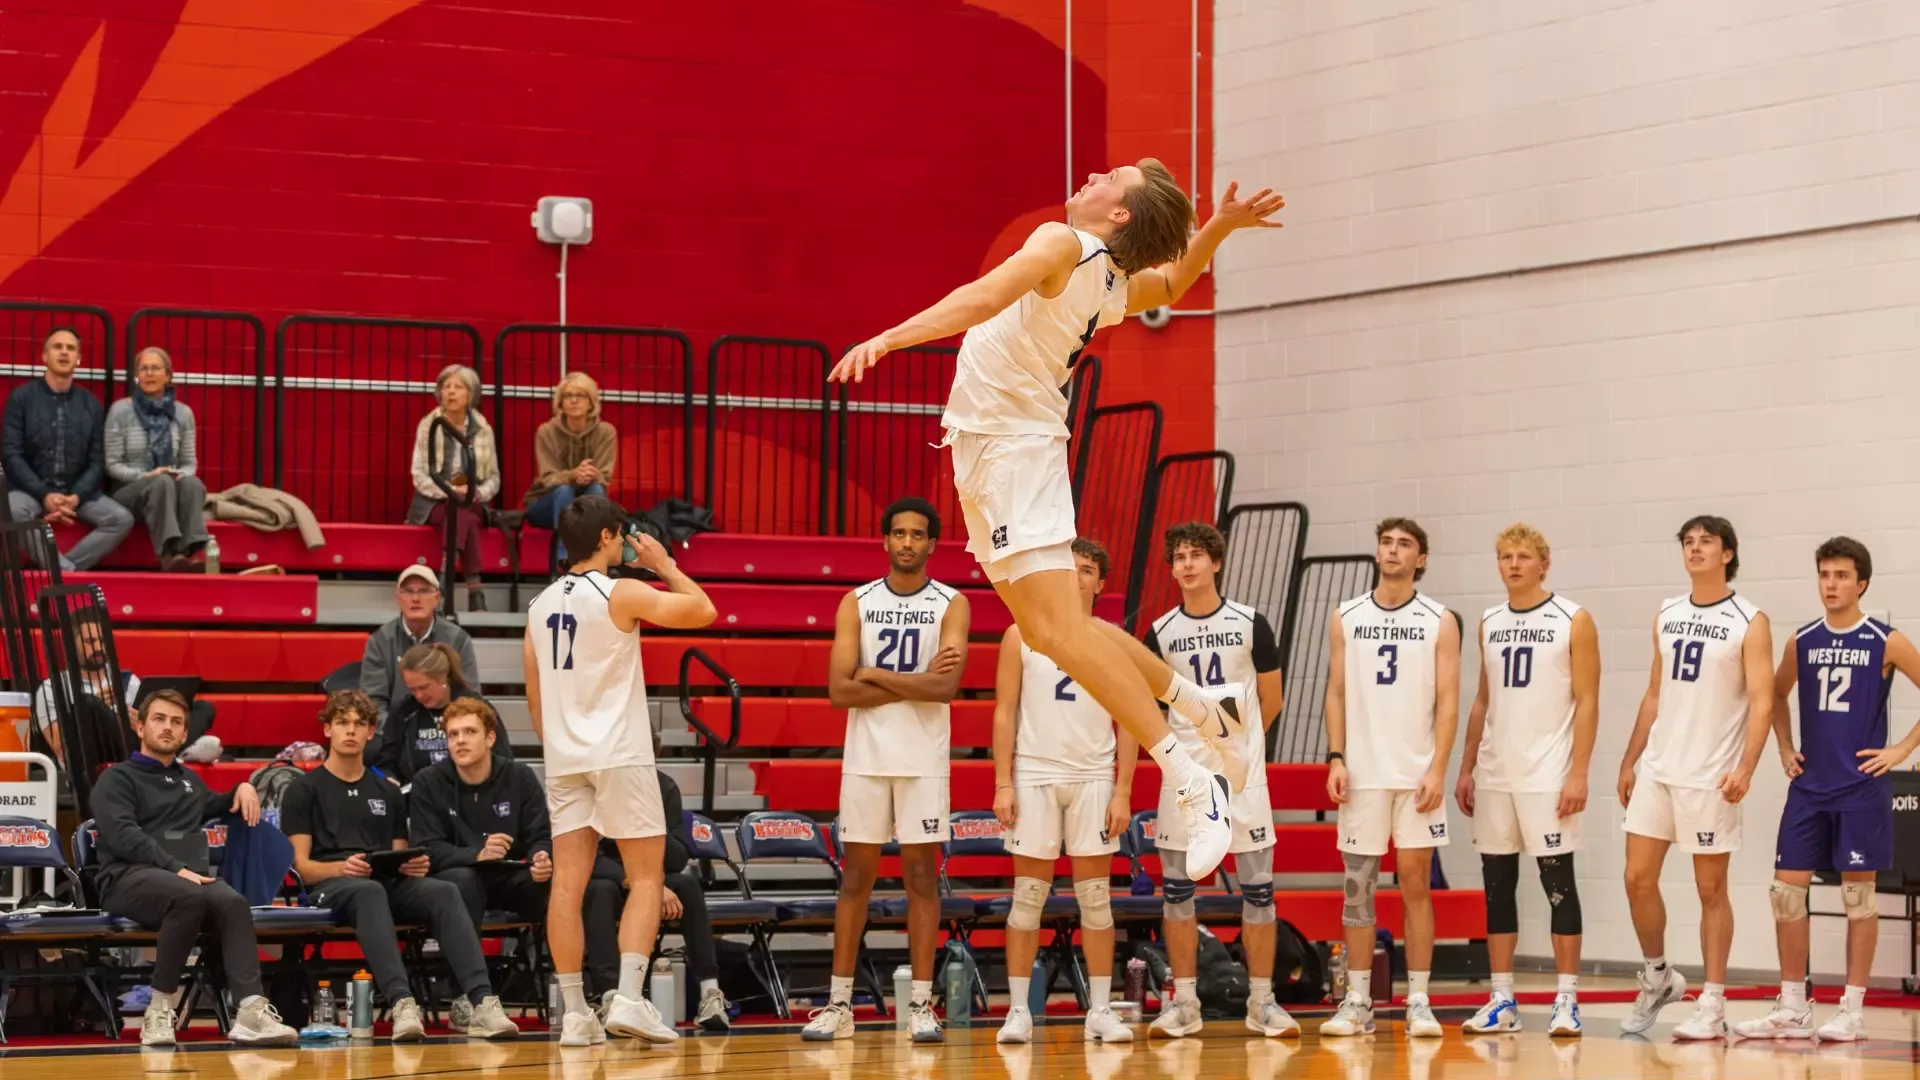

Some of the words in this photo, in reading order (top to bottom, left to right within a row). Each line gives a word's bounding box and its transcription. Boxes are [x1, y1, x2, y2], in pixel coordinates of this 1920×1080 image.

[865, 609, 936, 625] MUSTANGS
[1661, 620, 1730, 641] MUSTANGS
[547, 613, 578, 670] 17
[1168, 632, 1244, 654] MUSTANGS
[1353, 626, 1426, 641] MUSTANGS
[1488, 629, 1556, 644] MUSTANGS
[876, 628, 920, 672] 20
[1376, 644, 1398, 686] 3
[1671, 638, 1706, 683] 19
[1807, 648, 1871, 667] WESTERN
[1189, 651, 1226, 689] 14
[1501, 646, 1534, 688] 10
[1817, 666, 1852, 713] 12
[0, 795, 37, 806] RADE
